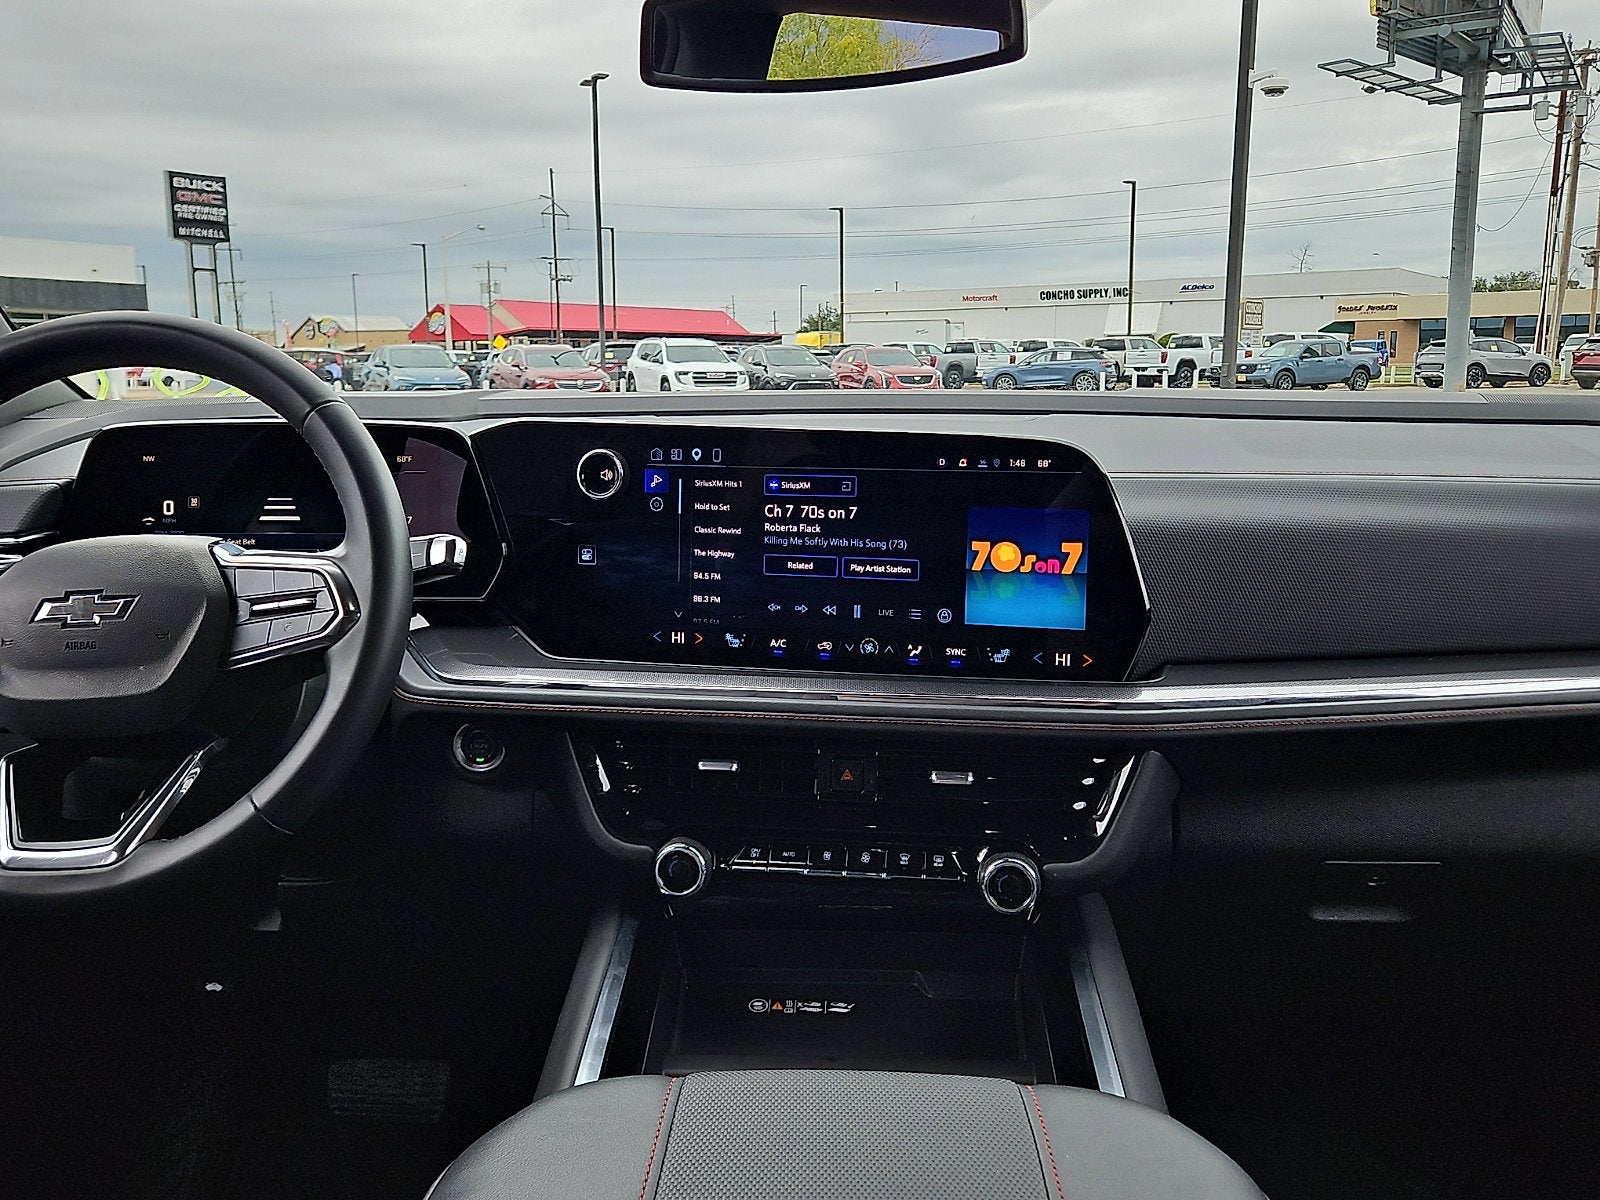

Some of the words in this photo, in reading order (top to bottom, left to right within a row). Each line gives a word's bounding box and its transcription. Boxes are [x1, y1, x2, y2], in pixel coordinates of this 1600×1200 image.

[172, 176, 225, 192] BUICK
[176, 189, 224, 205] GMC
[173, 203, 227, 216] CERTIFIED
[178, 226, 226, 239] MITCHELL
[1180, 283, 1215, 291] ACDelco
[961, 294, 998, 302] Motorcraft
[1039, 289, 1075, 301] CONCHO
[1076, 287, 1112, 299] SUPPLY,
[939, 458, 946, 466] D
[694, 479, 723, 488] SiriusXM
[724, 480, 738, 488] Hits
[781, 481, 811, 490] SiriusXM
[163, 500, 175, 516] 0
[694, 502, 710, 511] Hold
[710, 503, 718, 511] to
[719, 503, 731, 511] Set
[764, 503, 782, 518] Ch
[785, 504, 795, 518] 7
[800, 505, 825, 519] 70s
[828, 507, 846, 519] on
[848, 506, 858, 520] 7
[694, 525, 717, 534] Classic
[717, 526, 742, 535] Rewind
[764, 522, 798, 532] Roberta
[799, 523, 822, 533] Flack
[764, 535, 788, 547] Killing
[789, 536, 803, 546] Me
[804, 536, 828, 548] Softly
[829, 537, 849, 547] With
[850, 538, 864, 548] His
[865, 538, 887, 550] Song
[888, 540, 908, 550] (73)
[693, 548, 706, 557] The
[707, 549, 735, 559] Highway
[787, 561, 814, 570] Related
[850, 563, 865, 574] Play
[865, 564, 886, 573] Artist
[885, 565, 912, 574] Station
[710, 572, 721, 580] FM
[710, 595, 721, 603] FM
[878, 608, 895, 617] LIVE
[670, 631, 685, 645] HI
[769, 638, 788, 648] A/C
[64, 640, 97, 651] AIRBAG
[945, 647, 967, 657] SYNC
[1055, 652, 1071, 667] HI
